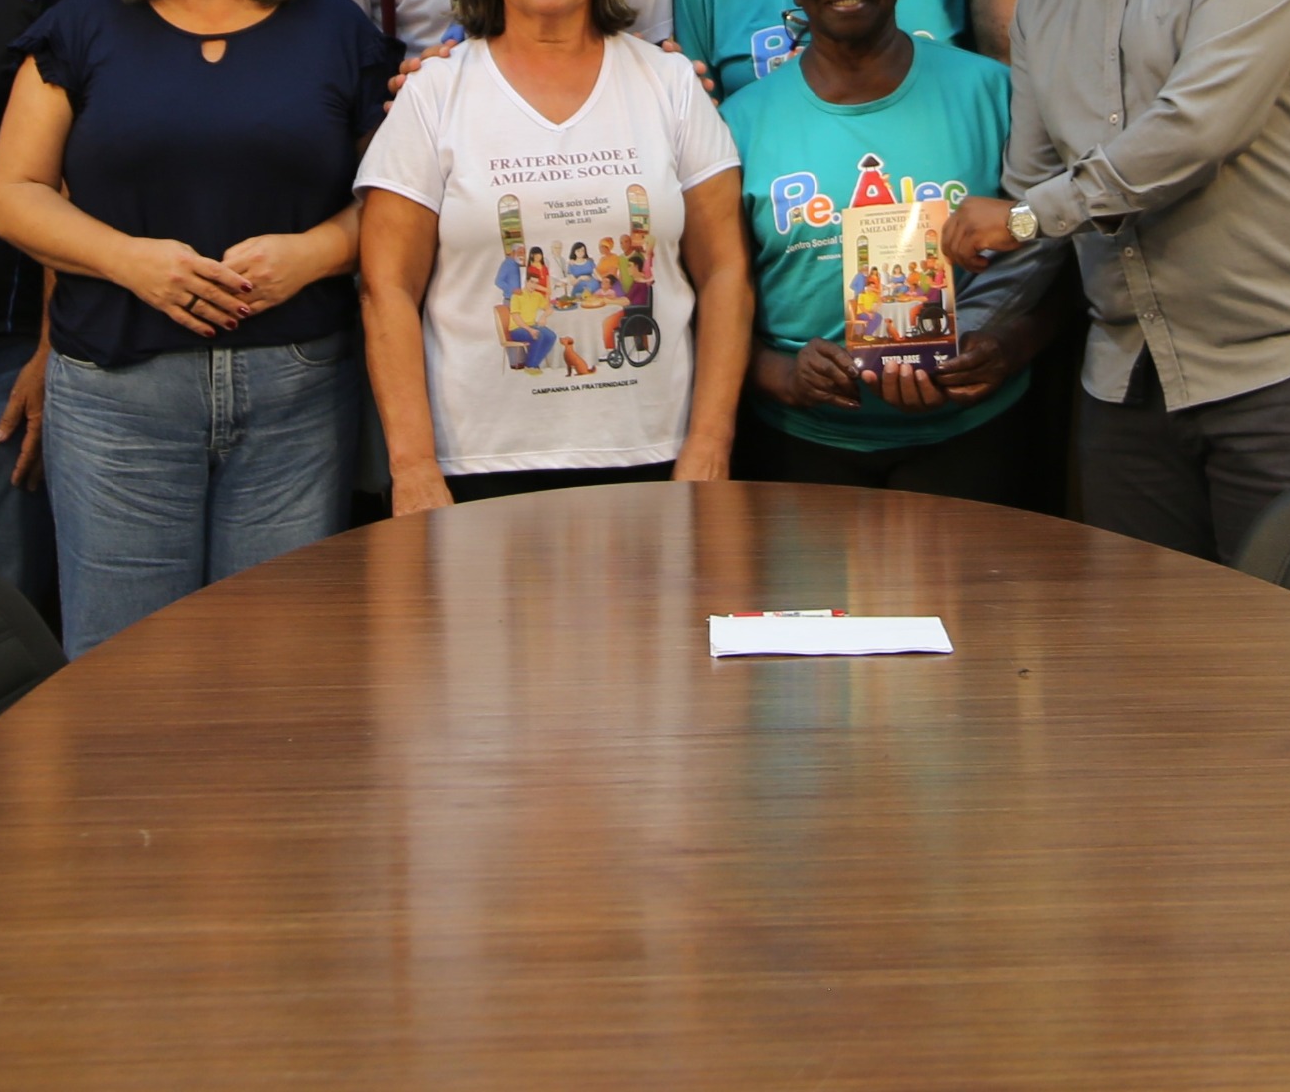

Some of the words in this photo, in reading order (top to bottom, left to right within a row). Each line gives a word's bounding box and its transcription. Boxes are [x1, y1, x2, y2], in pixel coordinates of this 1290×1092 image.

[489, 149, 624, 171] FRATERNIDADE
[626, 147, 639, 160] E
[490, 168, 574, 187] AMIZADE
[577, 163, 643, 179] SOCIAL
[566, 199, 583, 208] sois
[584, 197, 609, 206] todos
[771, 171, 841, 235] Pe.
[544, 210, 574, 219] irmãos
[860, 223, 899, 234] AMIZADE
[811, 235, 838, 248] Social
[532, 386, 570, 395] CAMPANHA
[581, 381, 629, 390] FRATERNIDADE
